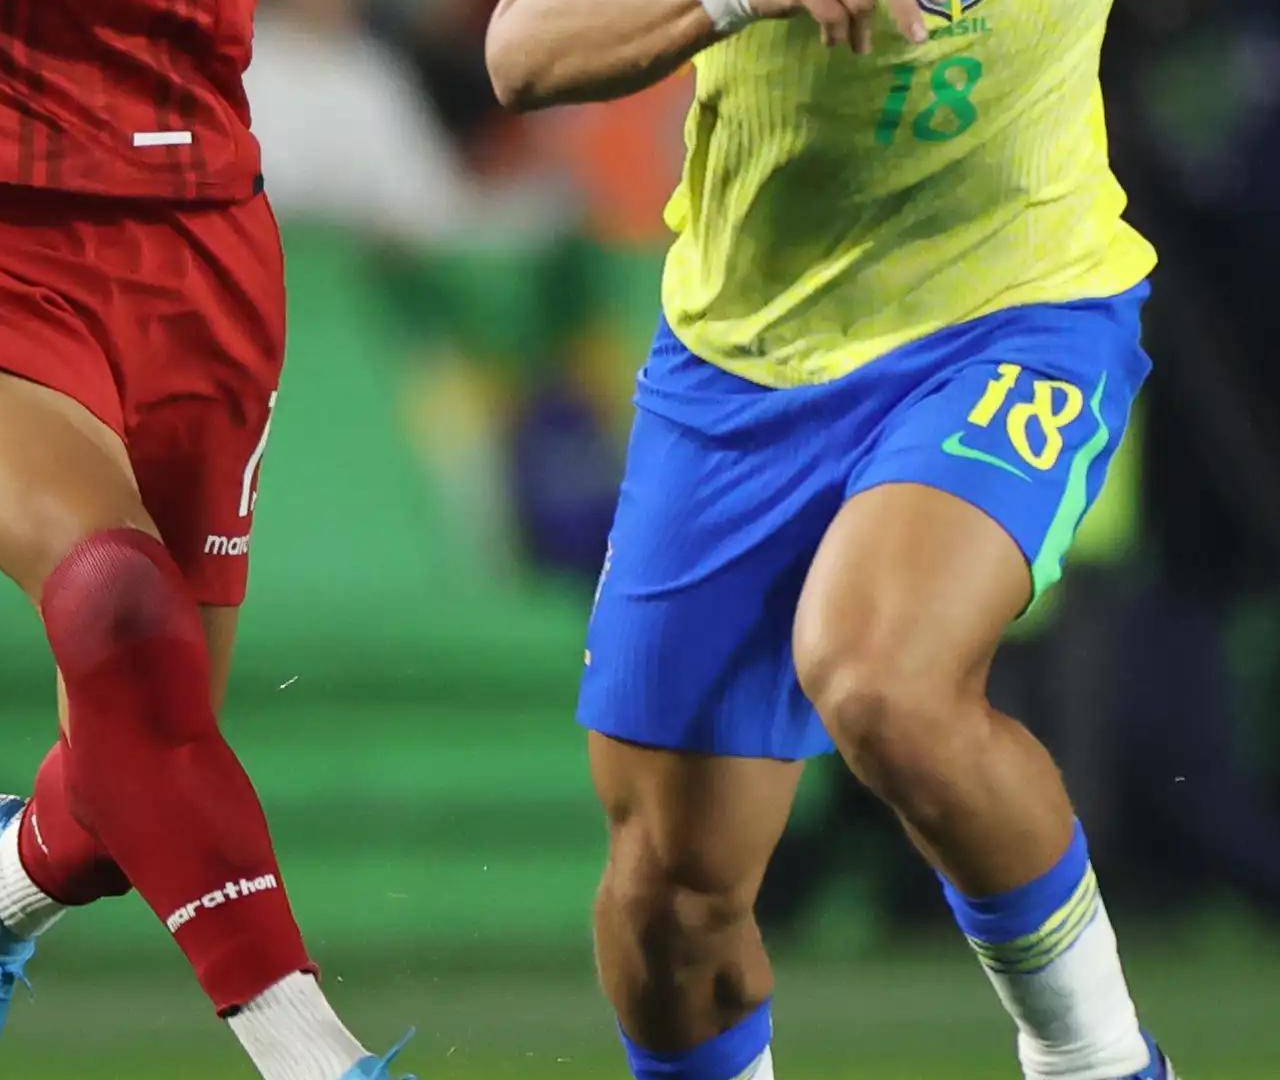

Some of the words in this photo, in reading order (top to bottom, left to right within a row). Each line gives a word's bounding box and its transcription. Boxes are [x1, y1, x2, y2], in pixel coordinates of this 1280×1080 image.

[875, 56, 983, 143] 18
[967, 363, 1084, 471] 18
[166, 873, 277, 933] marathon
